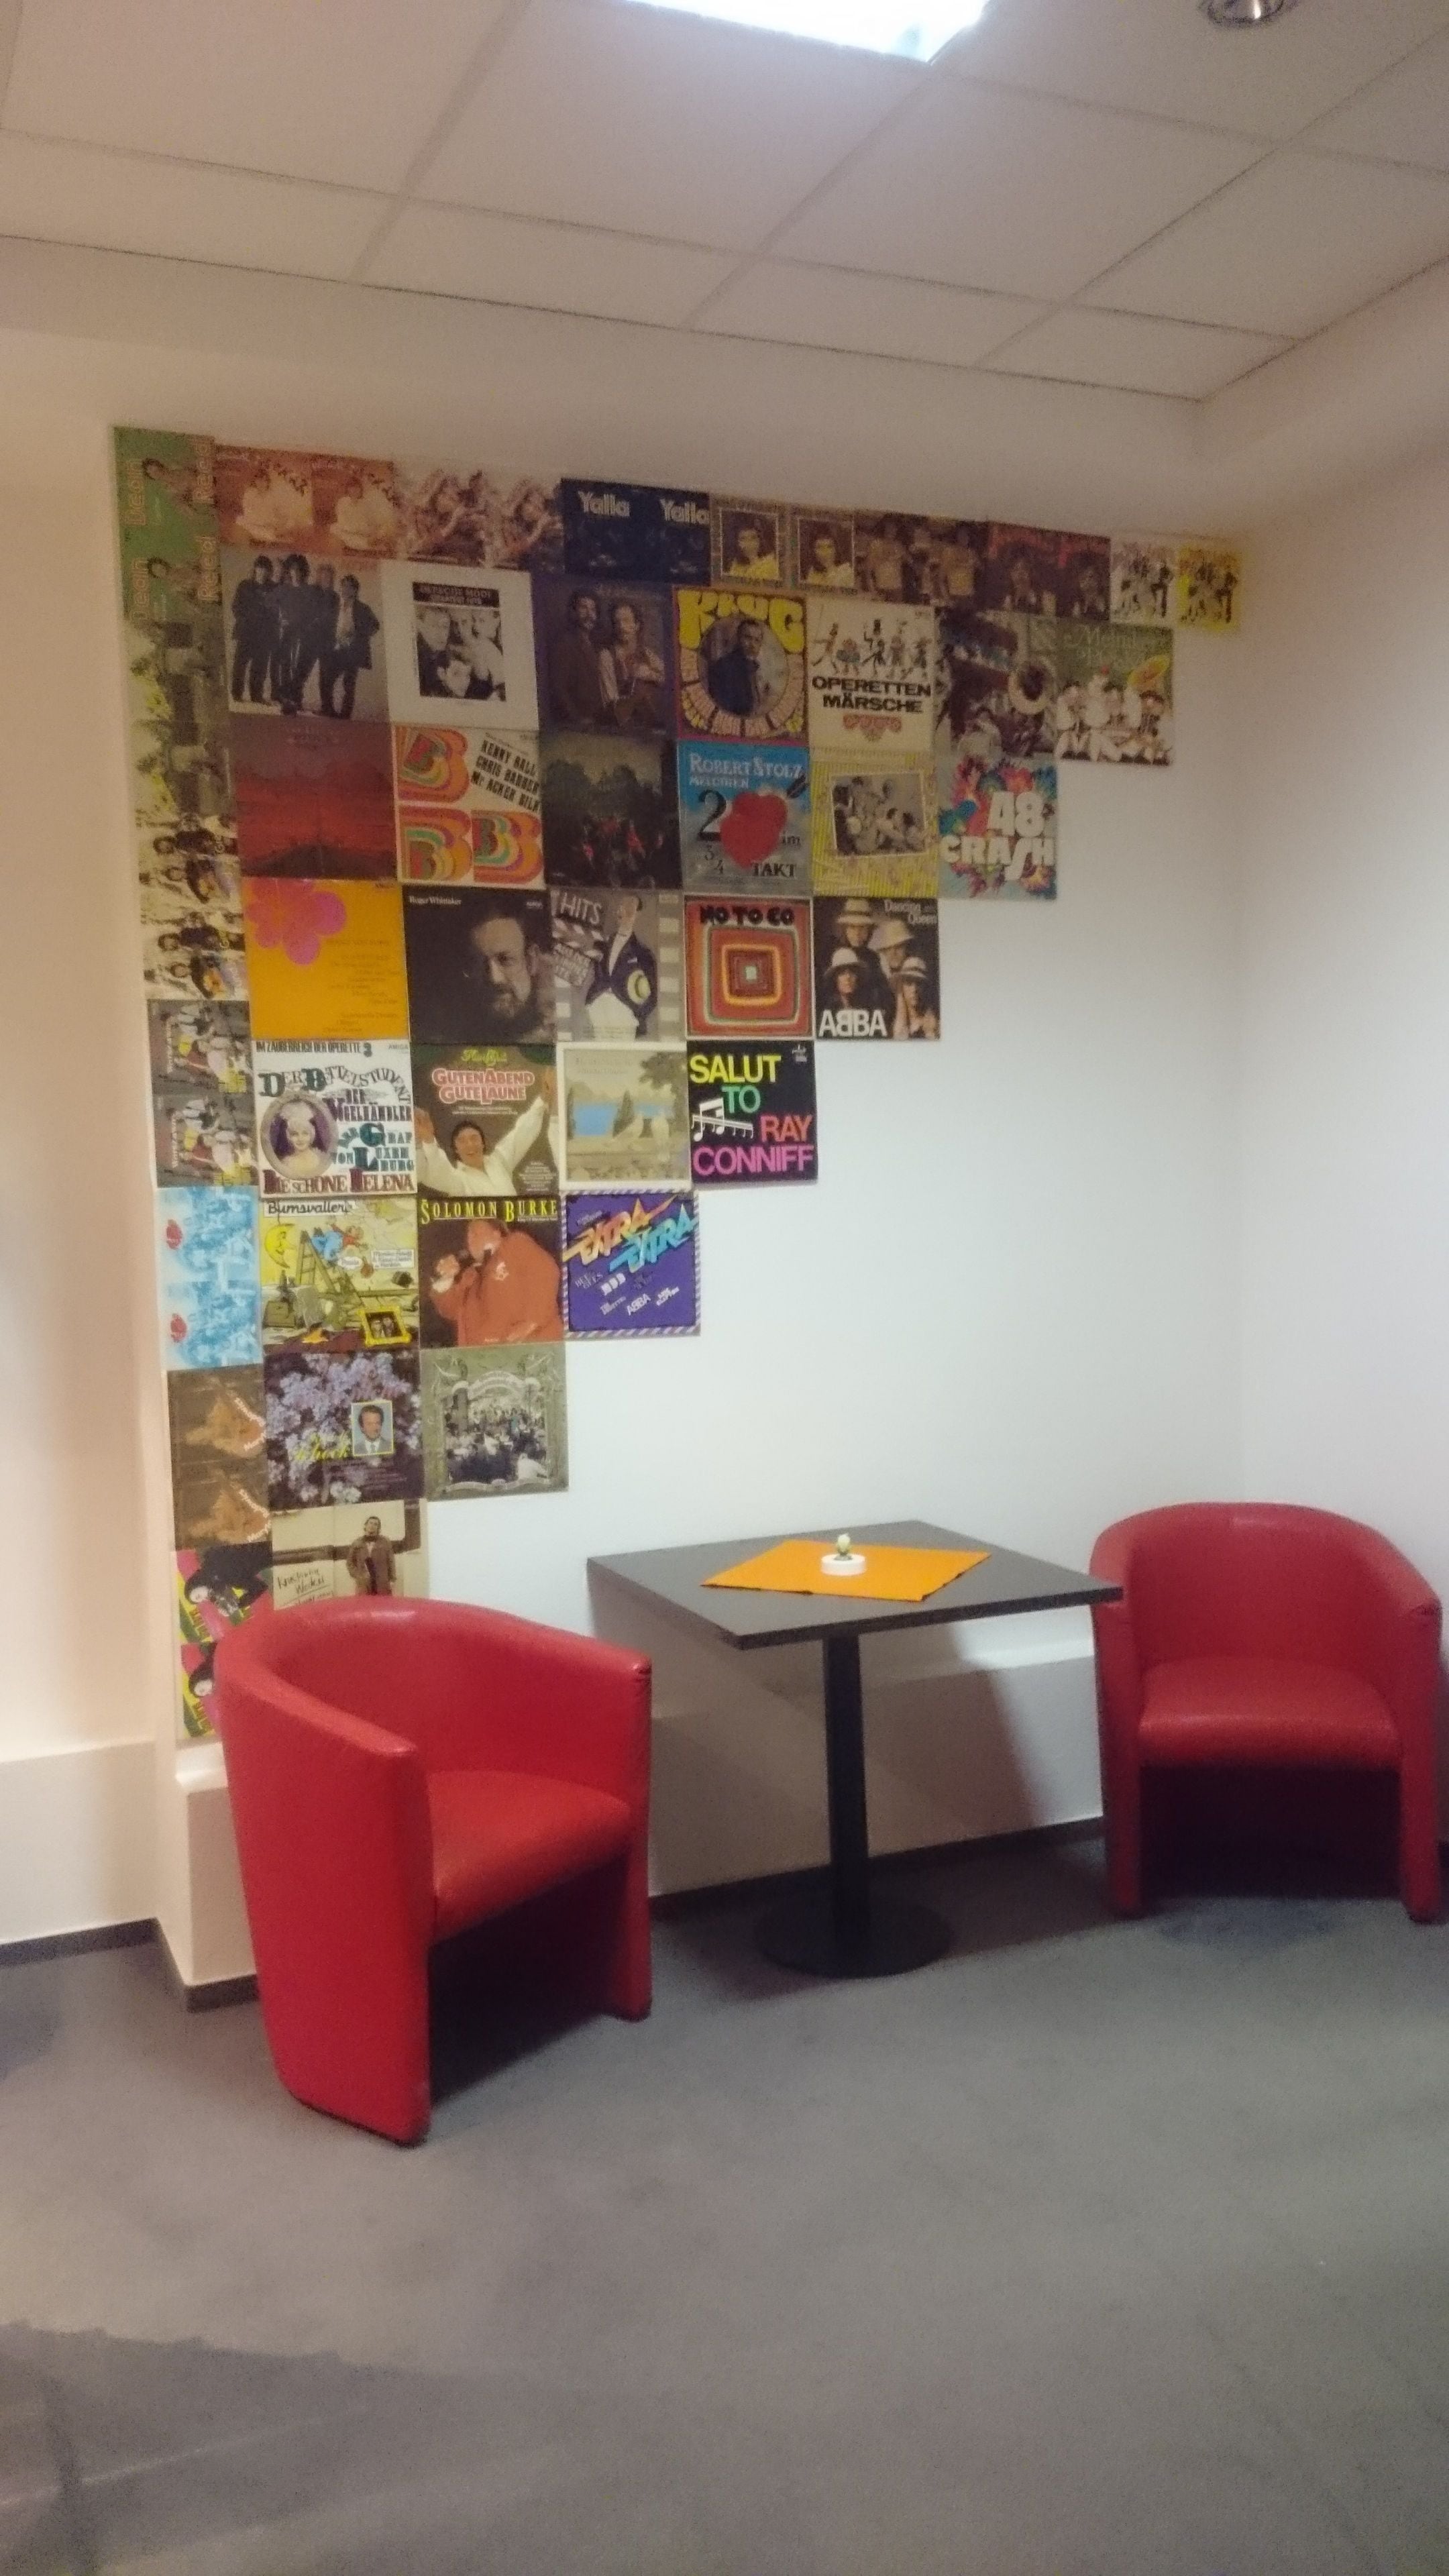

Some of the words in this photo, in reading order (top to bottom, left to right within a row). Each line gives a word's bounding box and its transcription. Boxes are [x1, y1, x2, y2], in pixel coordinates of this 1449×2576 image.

[578, 491, 630, 518] Yalla
[660, 498, 710, 525] Yalla
[812, 676, 930, 696] OPERETTEN
[823, 692, 922, 713] MÄRSCHE
[475, 755, 502, 777] CHRIS
[481, 740, 512, 764] KENNY
[513, 755, 537, 777] BALL
[690, 753, 749, 775] ROBERT
[753, 756, 804, 779] STOLZ
[988, 790, 1045, 839] 48
[750, 862, 798, 877] TAKT
[941, 834, 1055, 881] CRASH
[559, 892, 602, 925] HITS
[818, 1009, 888, 1038] ABBA
[690, 1055, 782, 1083] SALUT
[721, 1084, 761, 1114] TO
[759, 1114, 814, 1142] RAY
[692, 1144, 815, 1176] CONNIFF
[349, 1168, 415, 1191] HELENA
[421, 1199, 497, 1224] SOLOMON
[505, 1200, 558, 1223] BURKE
[562, 1194, 678, 1266] EXTRA
